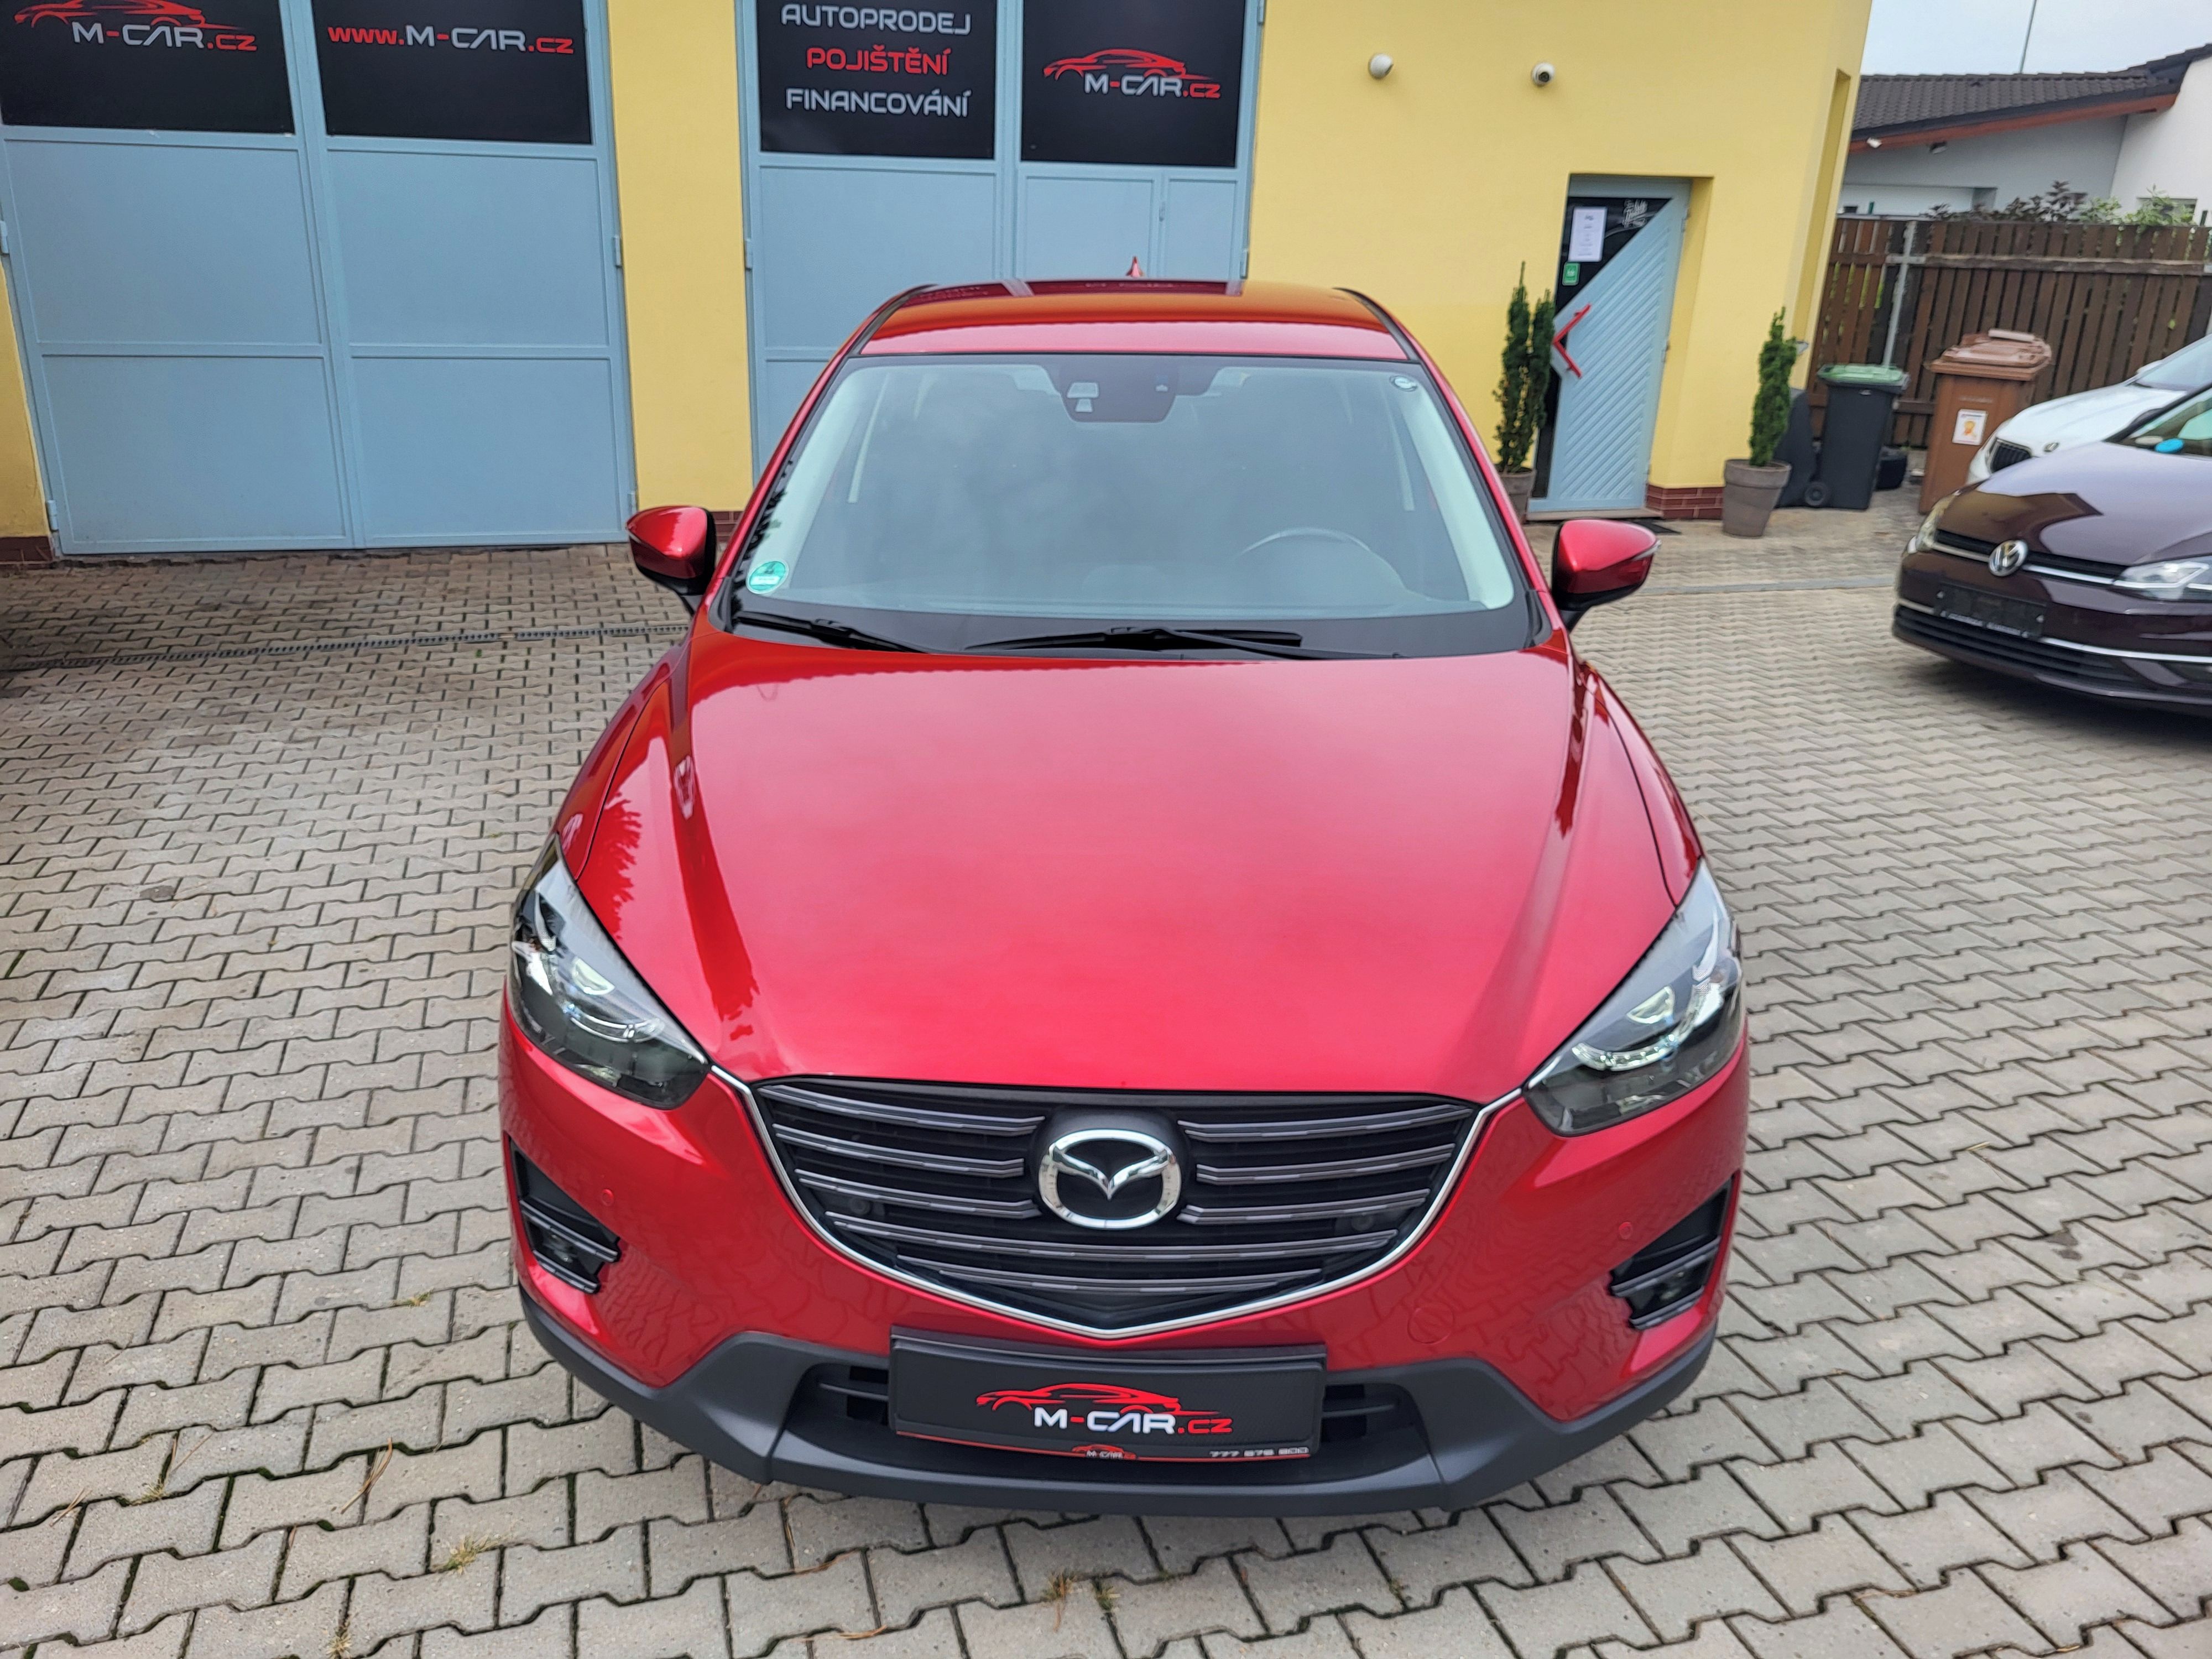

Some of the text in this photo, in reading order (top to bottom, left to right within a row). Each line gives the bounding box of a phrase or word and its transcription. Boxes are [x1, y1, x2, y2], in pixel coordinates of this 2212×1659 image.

[781, 3, 971, 35] AUTOPRODEJ
[806, 44, 952, 76] POJIŠTĚNÍ
[786, 87, 973, 118] FINANCOVÁNÍ
